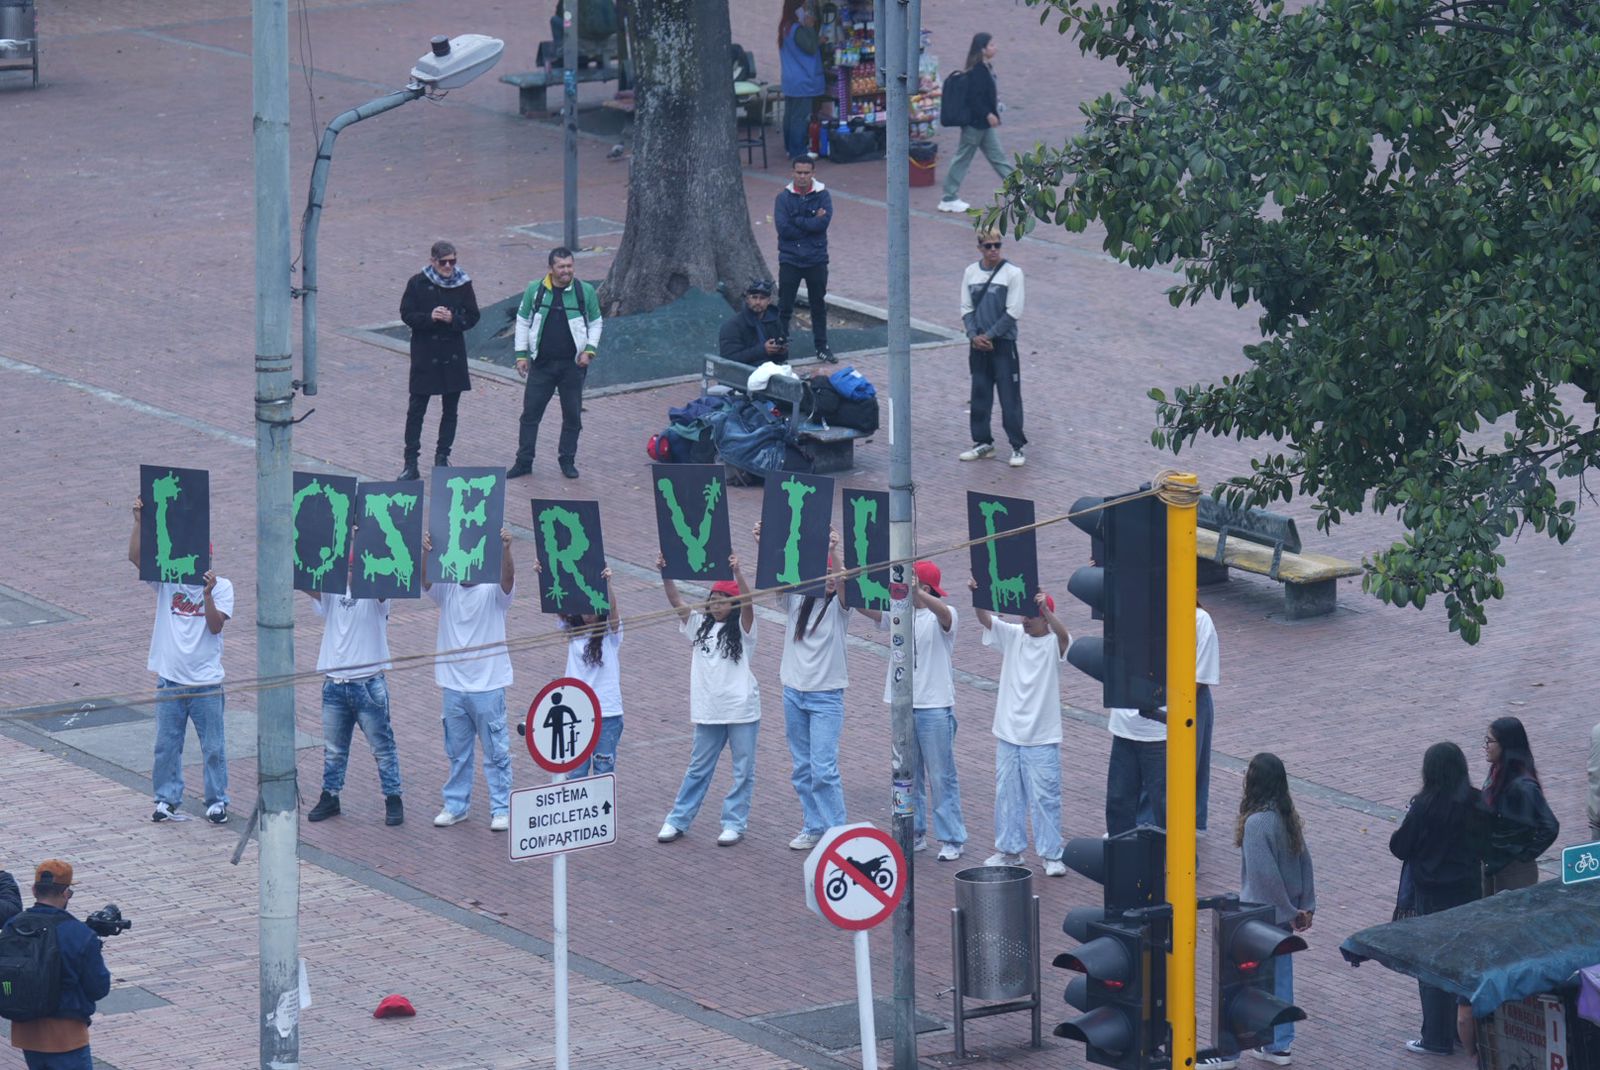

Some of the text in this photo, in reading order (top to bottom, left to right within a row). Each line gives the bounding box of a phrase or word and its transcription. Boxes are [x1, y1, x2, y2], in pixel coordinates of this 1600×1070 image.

[536, 787, 588, 807] SISTEMA
[529, 805, 599, 829] BICICLETAS
[520, 824, 607, 851] COMPARTIDAS
